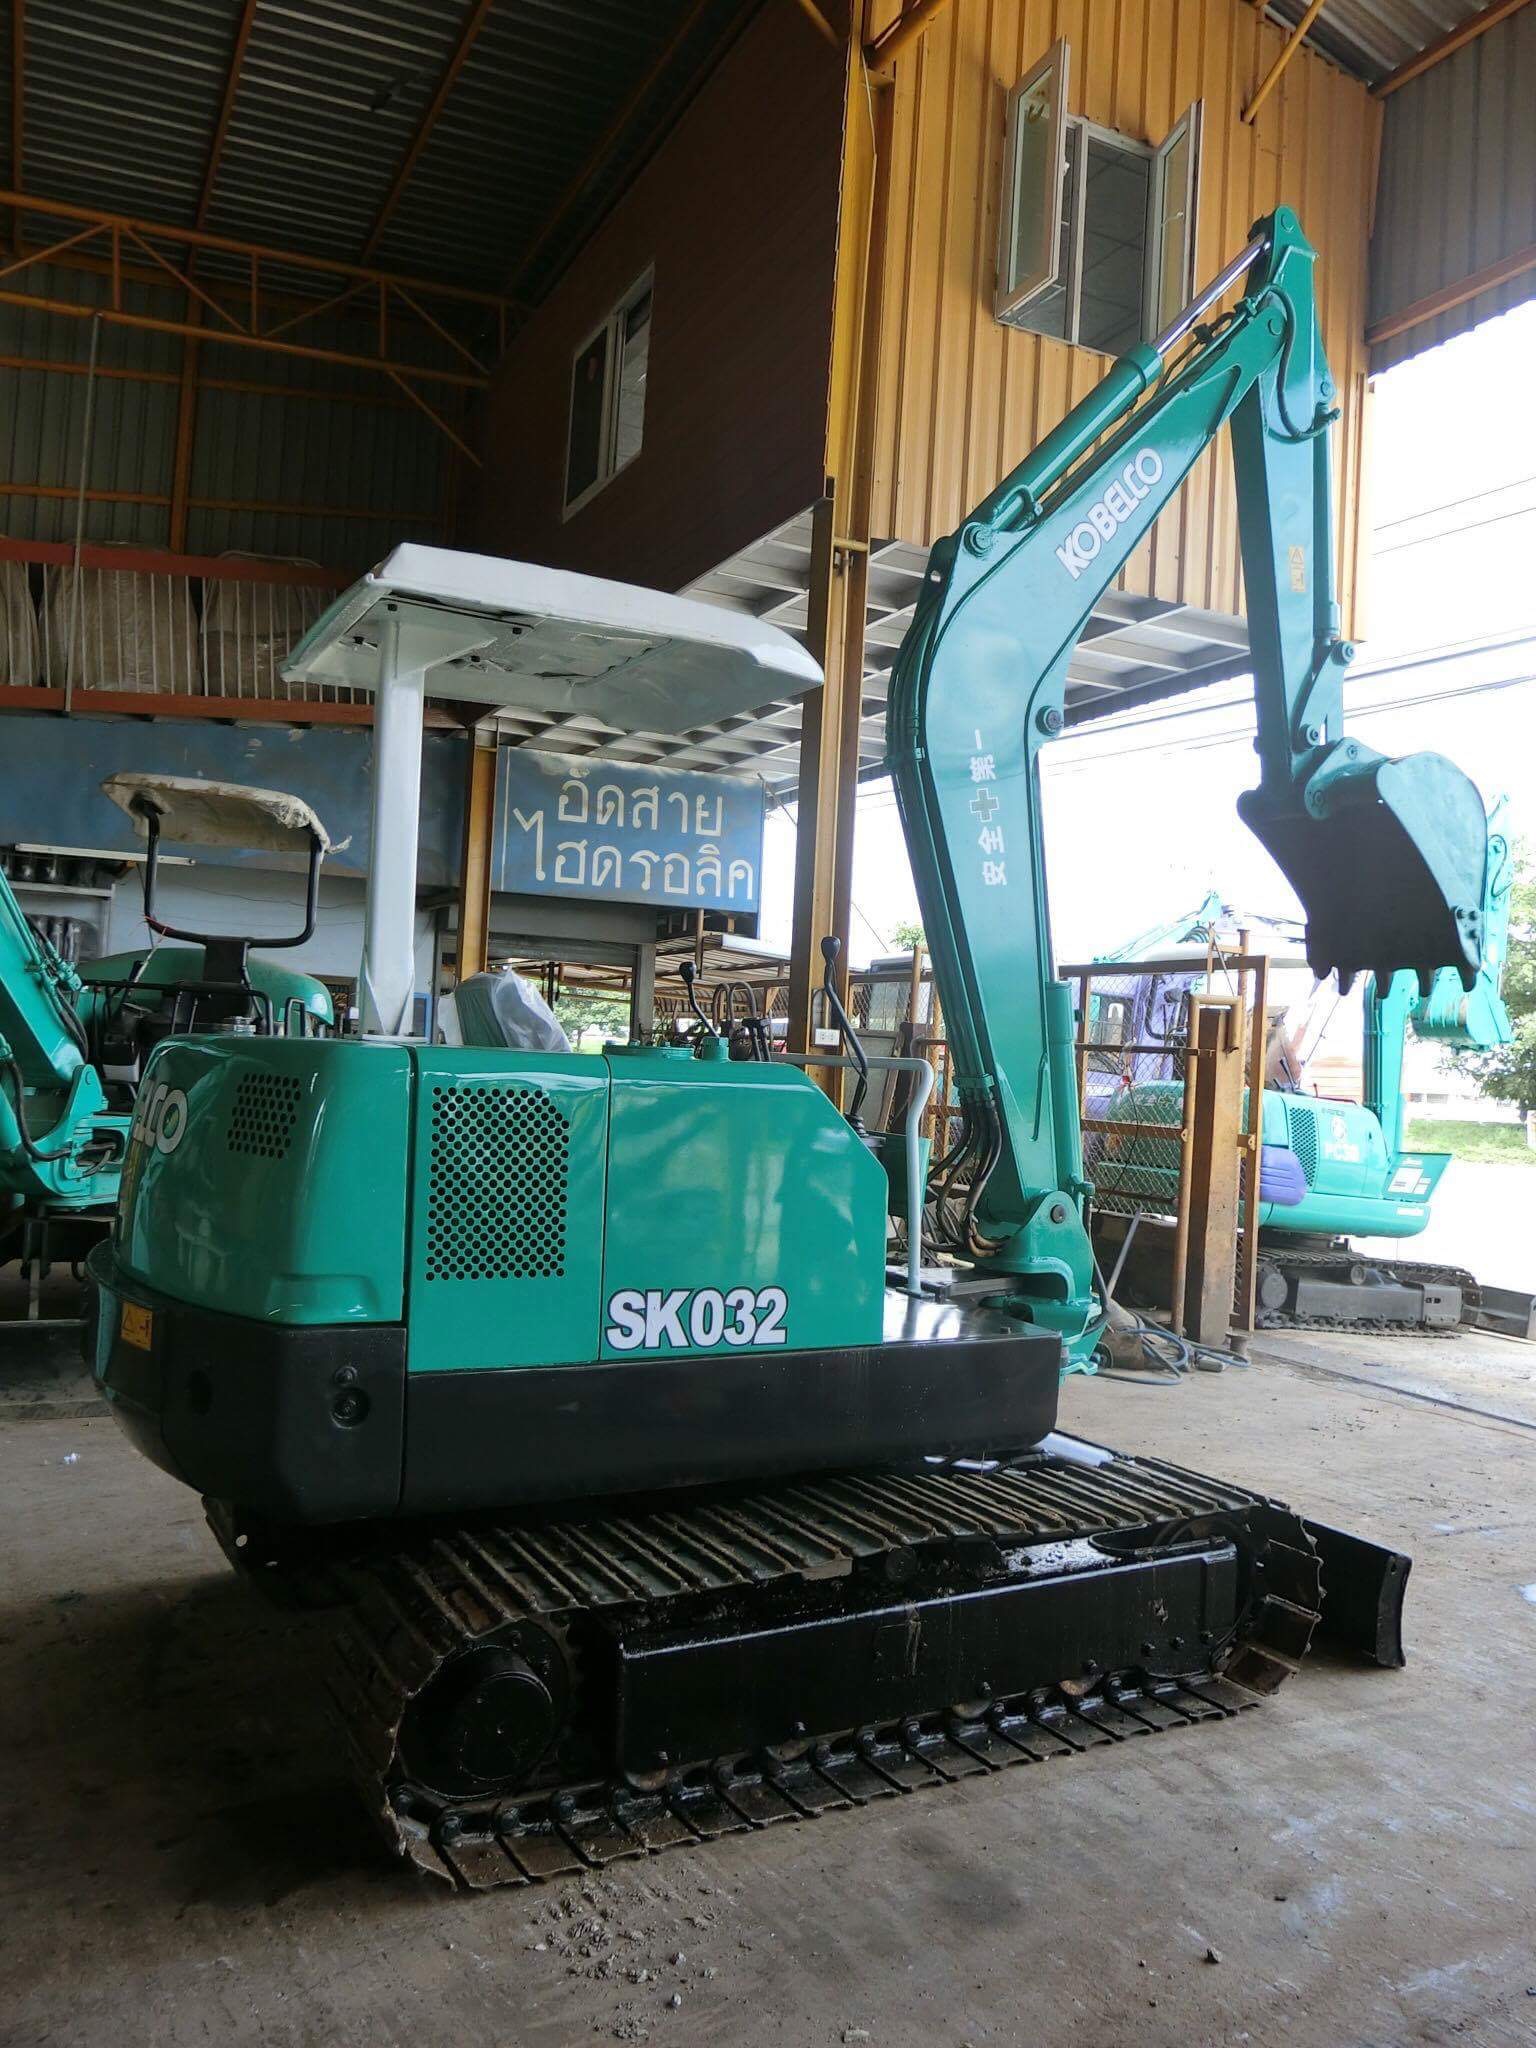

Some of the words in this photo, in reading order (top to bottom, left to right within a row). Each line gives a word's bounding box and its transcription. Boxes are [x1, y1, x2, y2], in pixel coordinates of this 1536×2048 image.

[1055, 447, 1163, 581] KOBELCO
[557, 767, 724, 837] อัดสาย
[512, 807, 754, 901] ไฮดรอลิค
[605, 1285, 789, 1350] SK032
